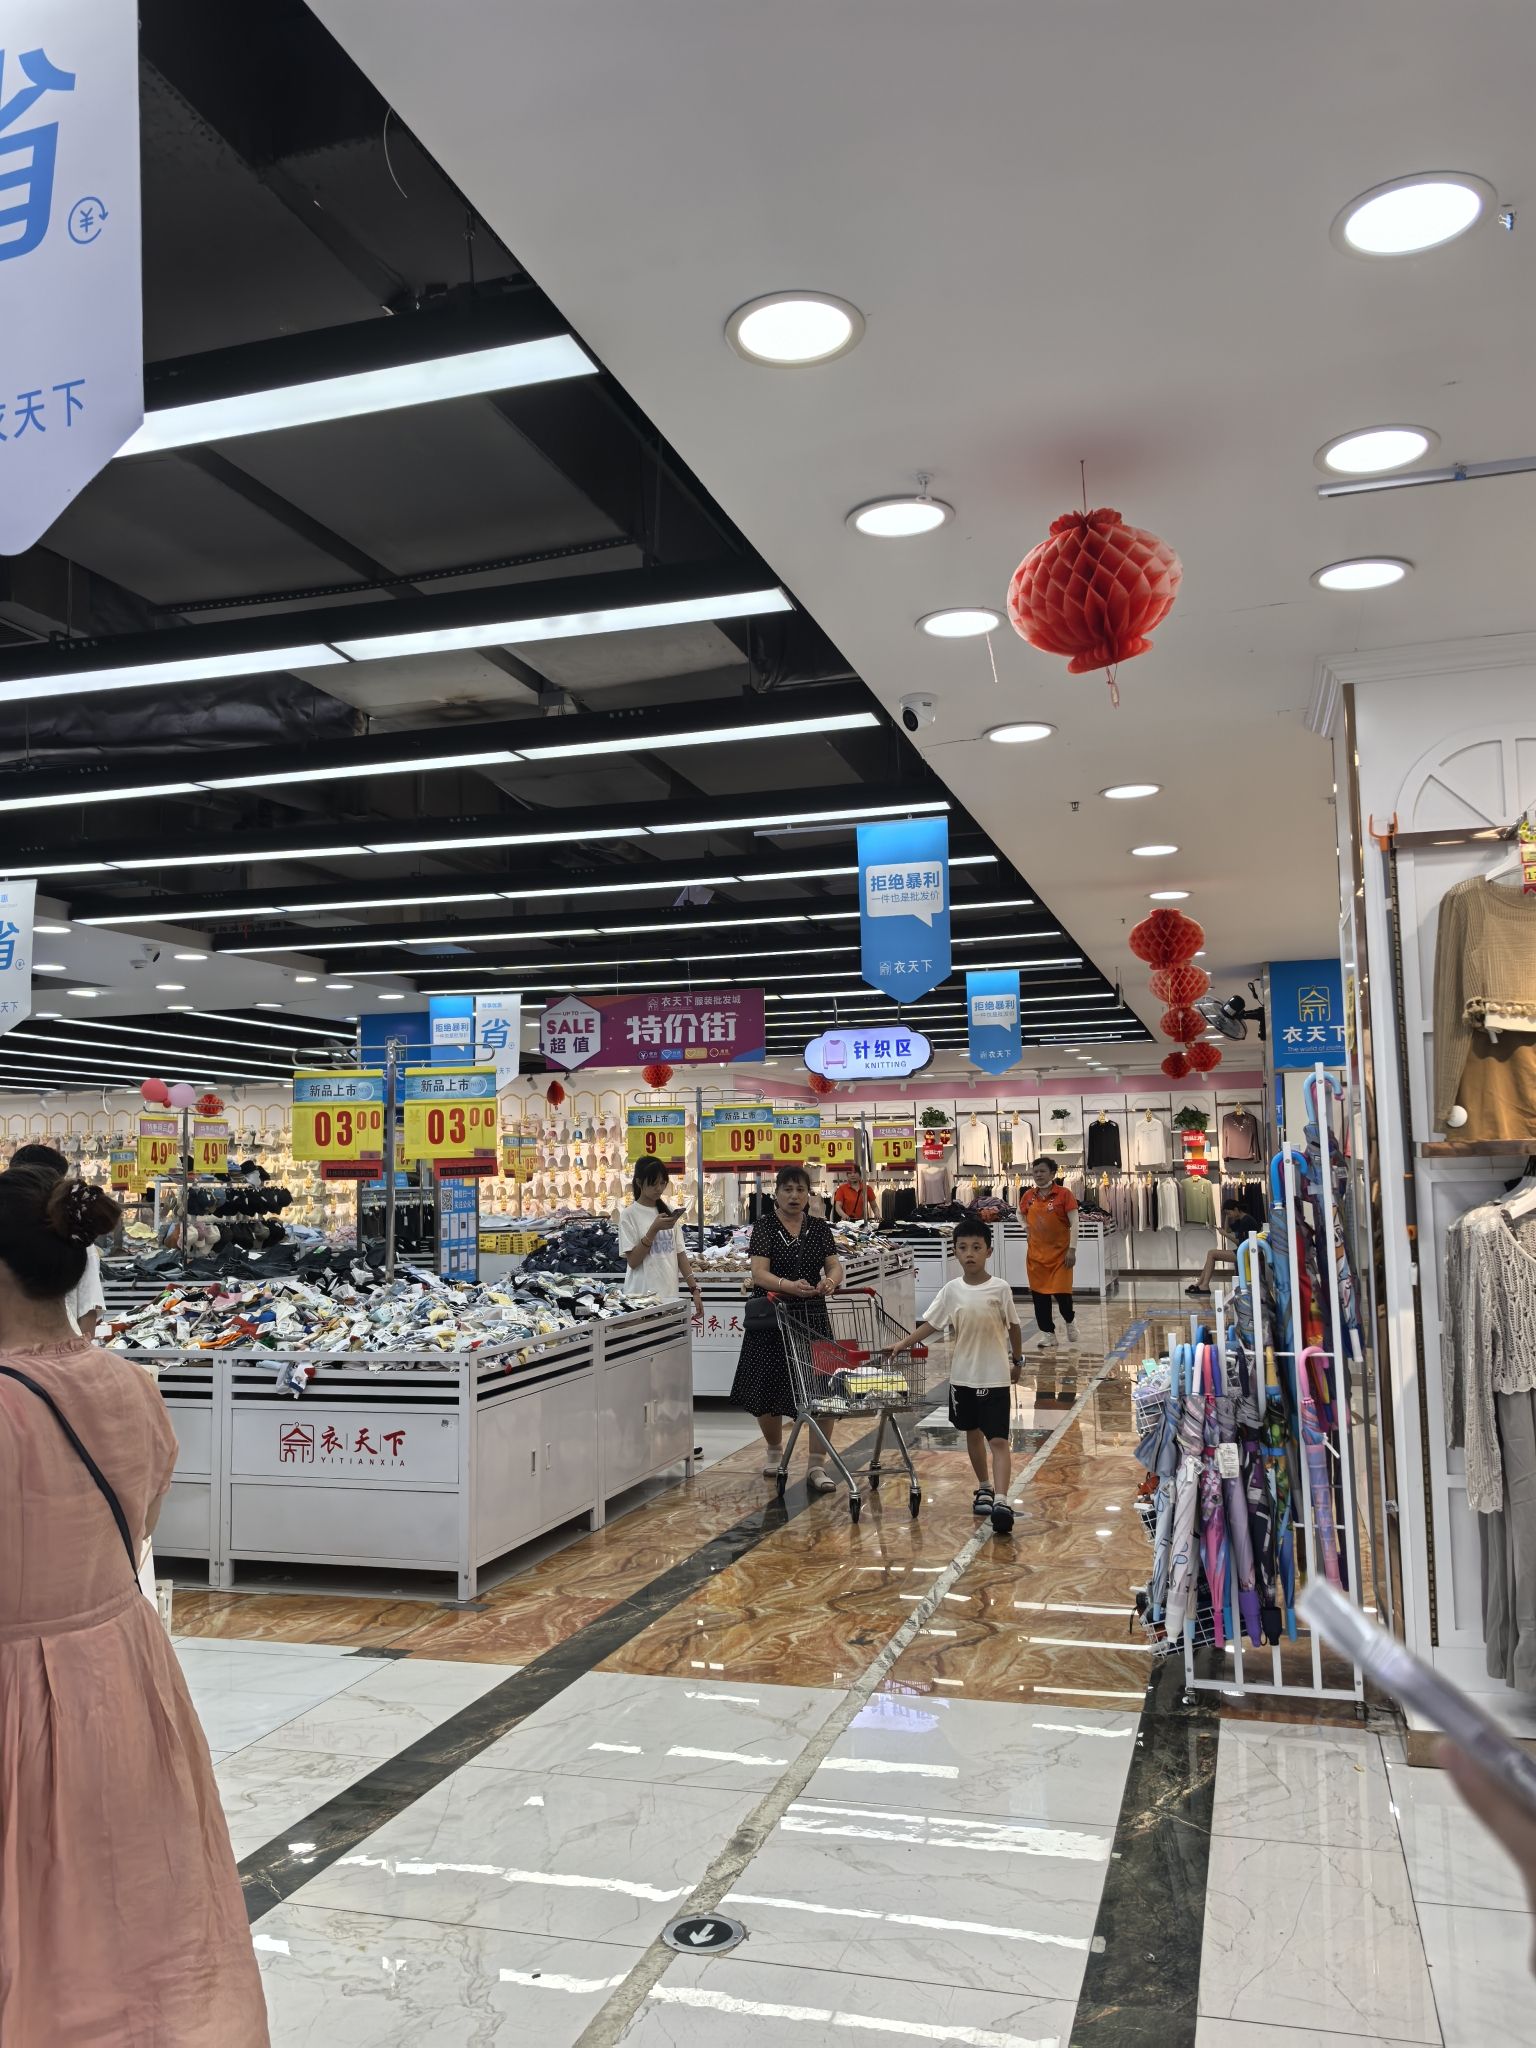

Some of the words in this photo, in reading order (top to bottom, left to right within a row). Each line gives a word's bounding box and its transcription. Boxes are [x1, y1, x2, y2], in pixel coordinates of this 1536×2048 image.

[0, 379, 86, 442] 天下
[870, 870, 940, 892] 拒绝暴利
[872, 890, 939, 903] 一件也是批发价
[894, 959, 932, 974] 衣天下
[974, 1000, 1015, 1011] 拒绝暴利
[481, 1017, 510, 1049] 省
[546, 1018, 595, 1035] SALE
[627, 1011, 738, 1044] 特价街
[550, 1036, 590, 1054] 超值
[853, 1039, 912, 1060] 针织区
[864, 1060, 907, 1069] KNITTING
[309, 1084, 357, 1097] 新品上市
[420, 1078, 470, 1092] 新品上市
[637, 1115, 669, 1124] 新品上市
[724, 1111, 756, 1121] 新品上市
[776, 1117, 804, 1125] 新品上市
[320, 1425, 406, 1457] 衣天下
[320, 1457, 405, 1467] YITIANXIA
